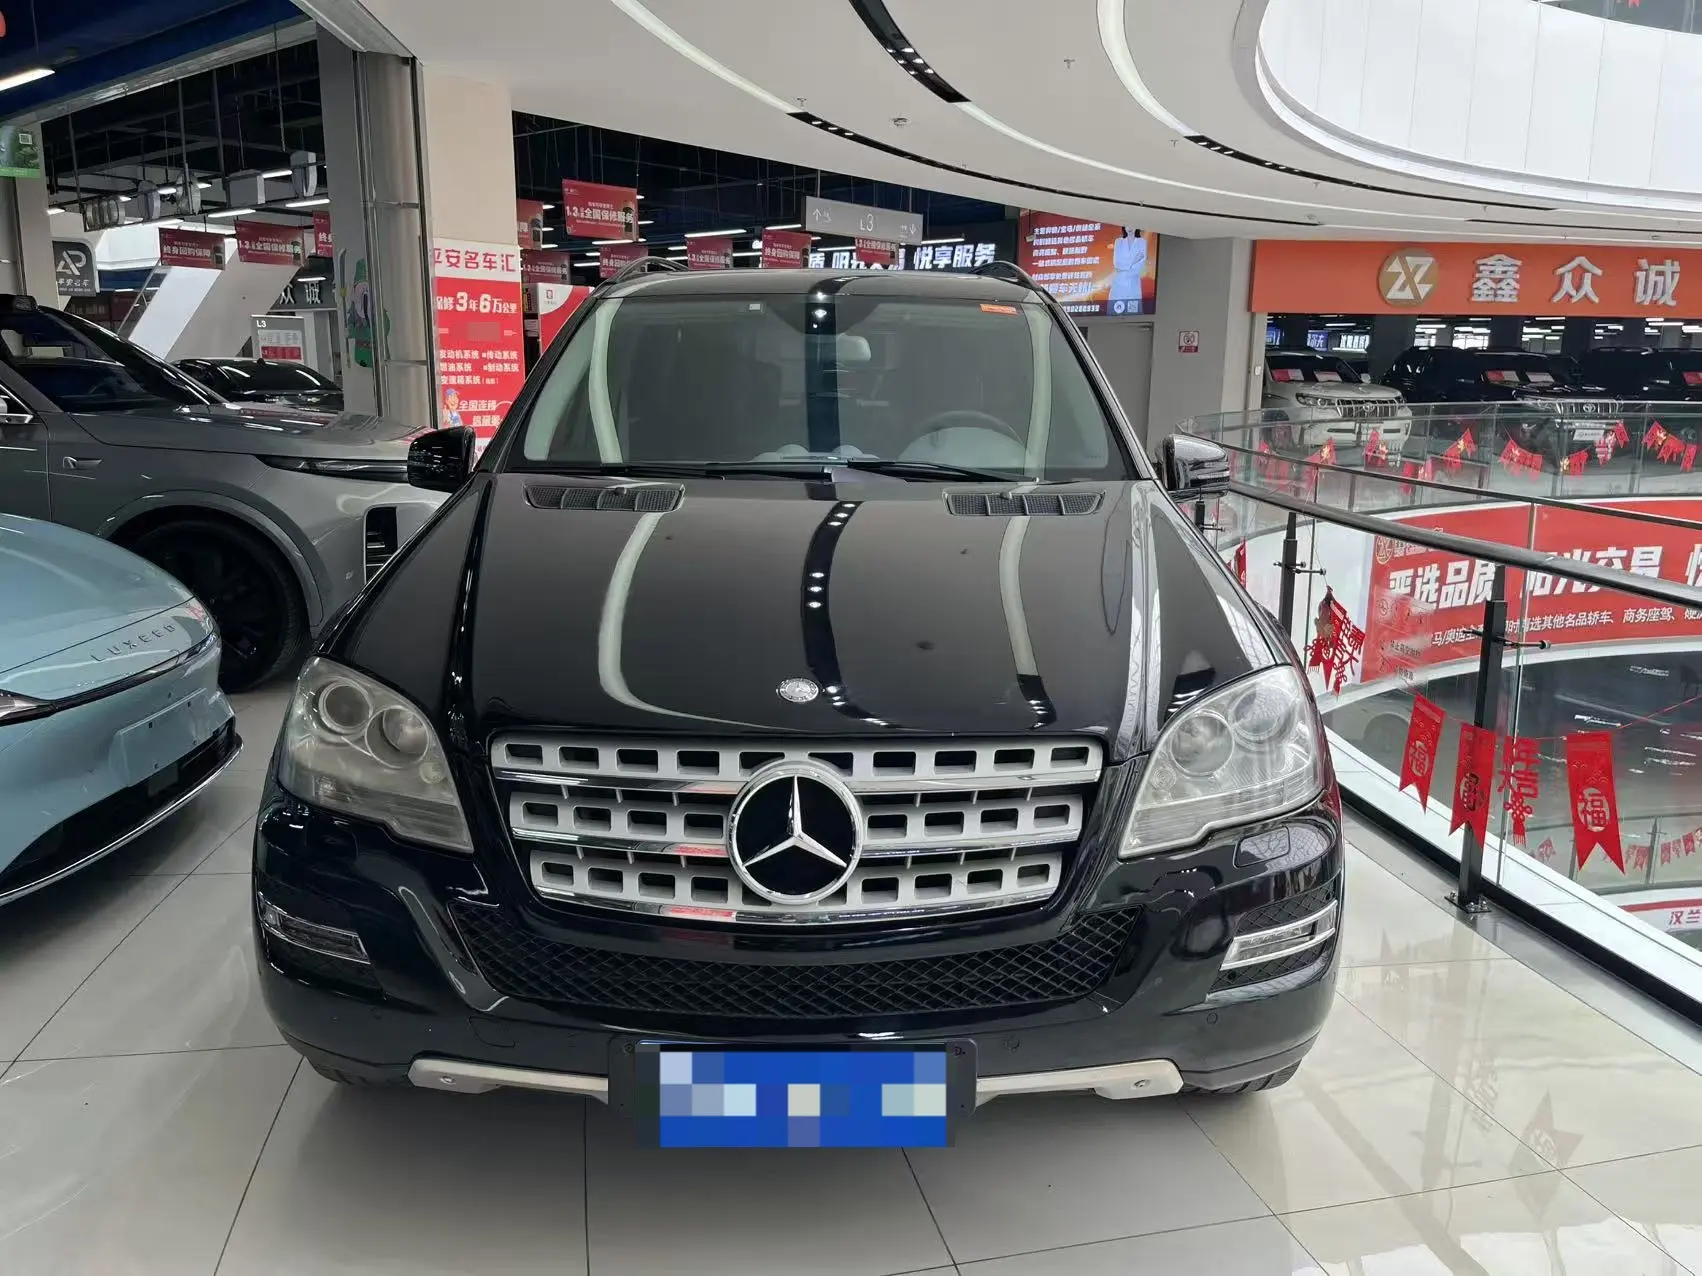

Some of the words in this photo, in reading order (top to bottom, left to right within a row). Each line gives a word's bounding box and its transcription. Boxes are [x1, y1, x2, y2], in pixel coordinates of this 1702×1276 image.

[914, 243, 996, 270] 悦享服务
[1471, 253, 1681, 306] 鑫众诚
[256, 319, 267, 328] L3
[90, 624, 176, 662] LUXEED
[1577, 787, 1610, 832] 福
